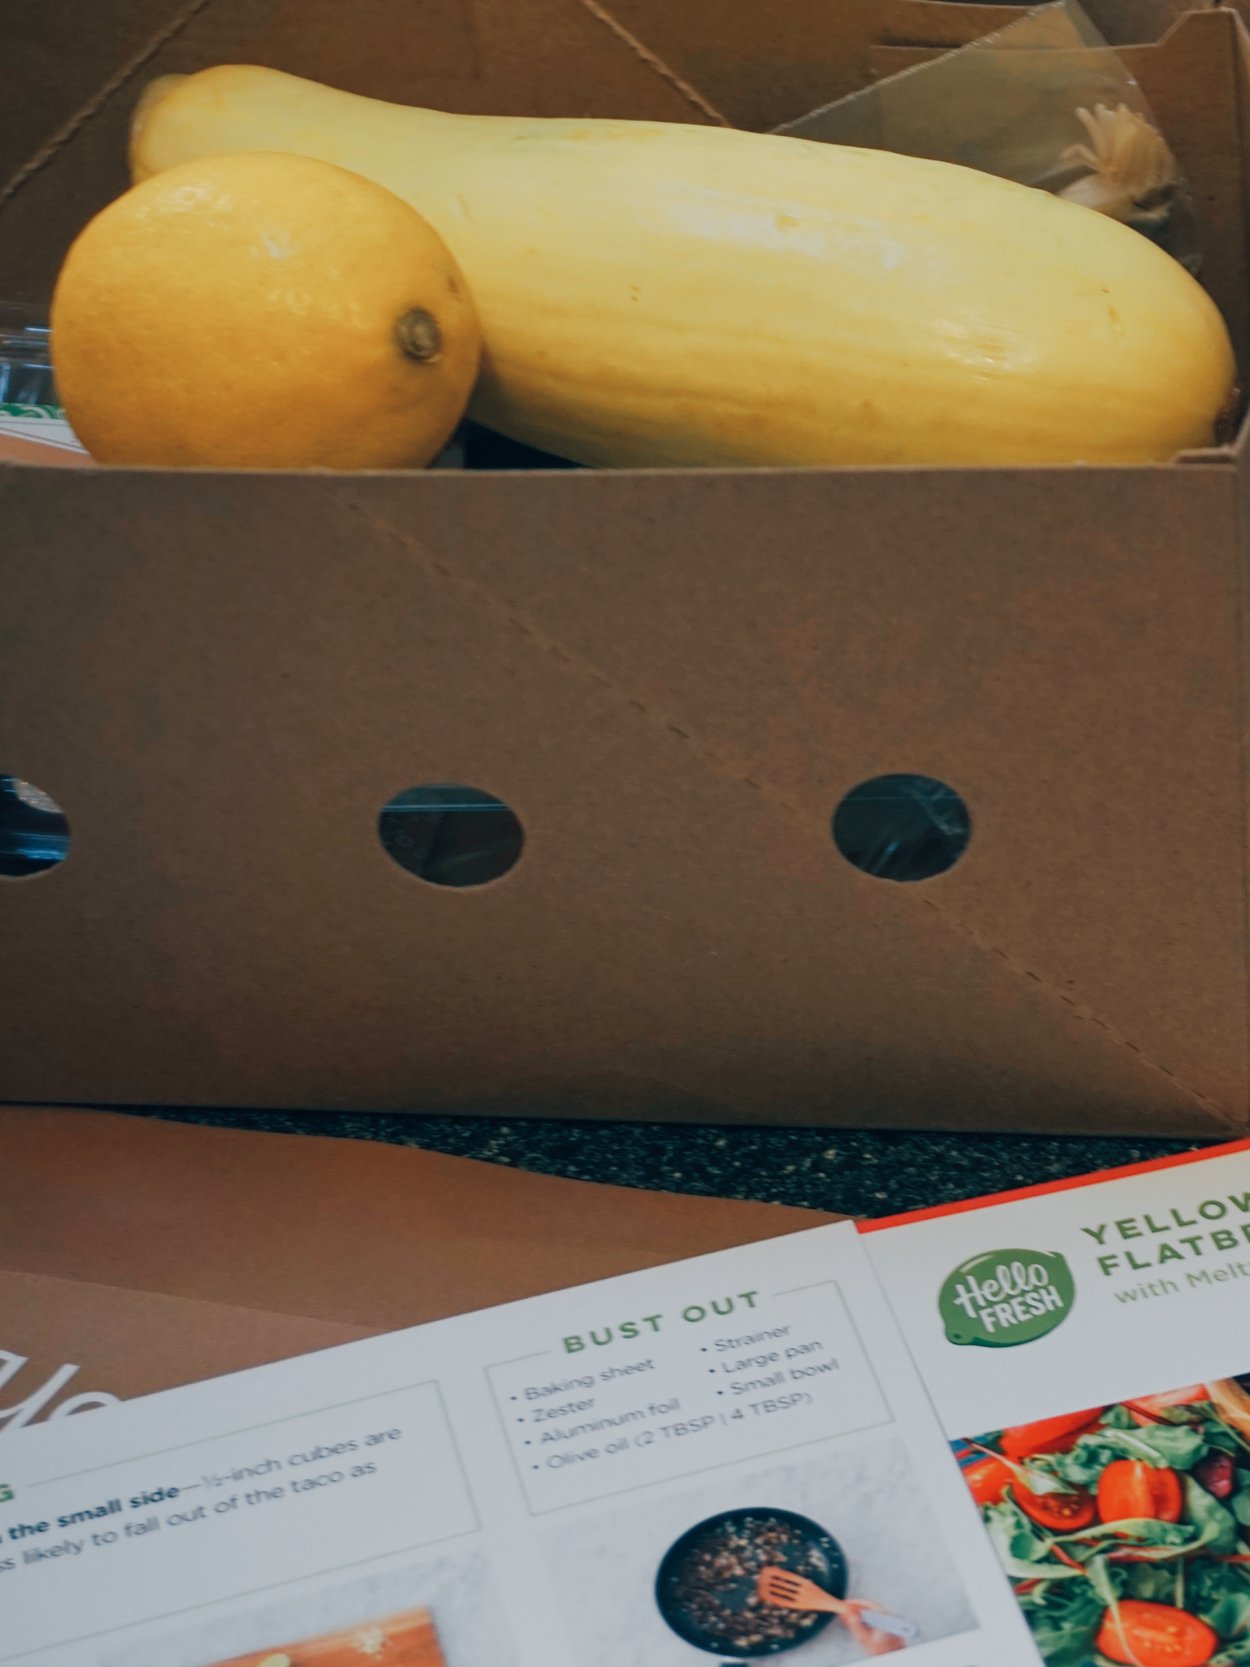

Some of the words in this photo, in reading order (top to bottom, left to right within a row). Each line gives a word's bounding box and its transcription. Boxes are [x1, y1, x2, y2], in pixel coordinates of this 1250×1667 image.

[953, 1261, 1048, 1318] Hello
[979, 1285, 1064, 1333] FRESH
[1114, 1278, 1180, 1305] with
[562, 1314, 663, 1353] BUST
[682, 1291, 758, 1323] OUT
[714, 1325, 791, 1352] Strainer
[523, 1375, 595, 1401] Baking
[600, 1359, 656, 1381] sheet
[721, 1351, 780, 1374] Large
[784, 1340, 824, 1360] pan
[729, 1371, 786, 1395] Small
[789, 1357, 840, 1380] bowl
[531, 1398, 596, 1423] Zester
[539, 1408, 645, 1445] Aluminum
[648, 1397, 681, 1416] foil
[546, 1448, 600, 1469] Olive
[604, 1437, 631, 1454] oil
[658, 1415, 715, 1439] TBSP
[748, 1392, 814, 1416] TBSP)
[8, 1520, 50, 1540] the
[57, 1499, 122, 1527] small
[287, 1439, 359, 1466] cubes
[365, 1428, 402, 1447] are
[22, 1539, 84, 1566] likely
[91, 1531, 119, 1546] to
[124, 1516, 160, 1537] fall
[166, 1506, 207, 1526] out
[214, 1496, 238, 1513] of
[245, 1486, 285, 1505] the
[290, 1471, 345, 1493] taco
[350, 1462, 377, 1477] as
